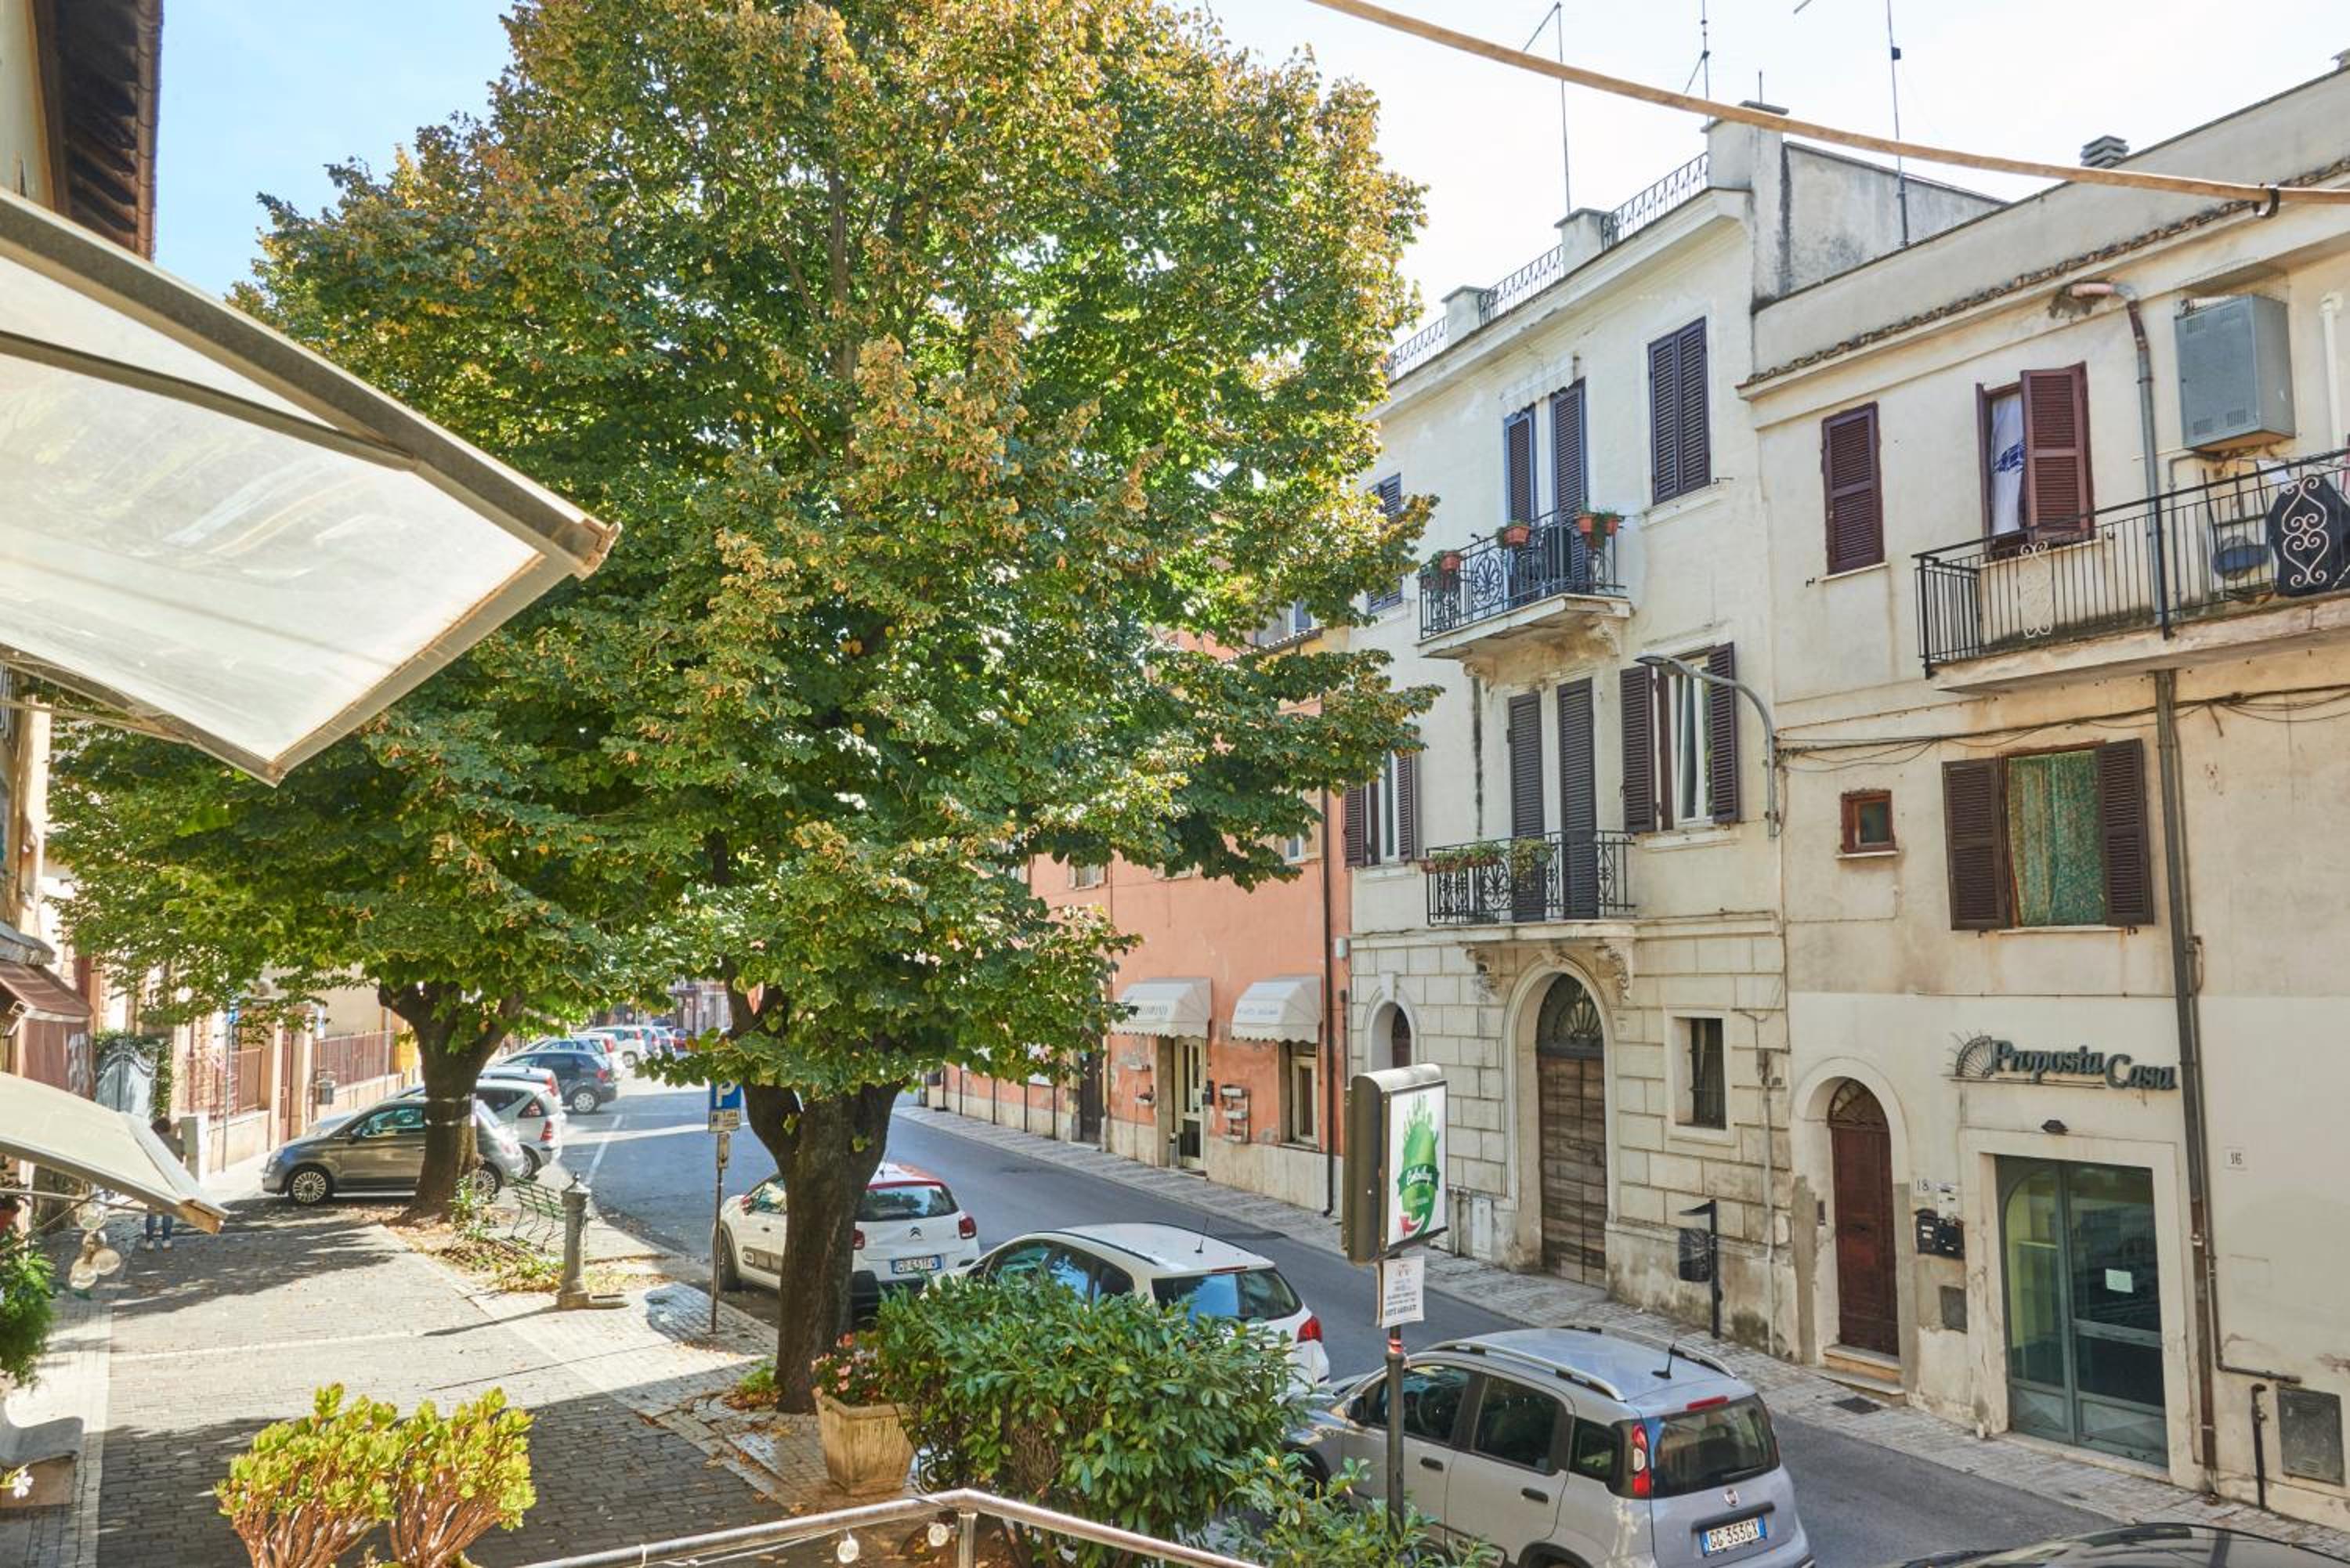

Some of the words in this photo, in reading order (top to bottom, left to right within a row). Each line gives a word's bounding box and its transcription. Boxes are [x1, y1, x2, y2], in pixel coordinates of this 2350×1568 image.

[1993, 1039, 2105, 1084] Proposta
[2105, 1053, 2177, 1089] Casa
[716, 1078, 736, 1107] P
